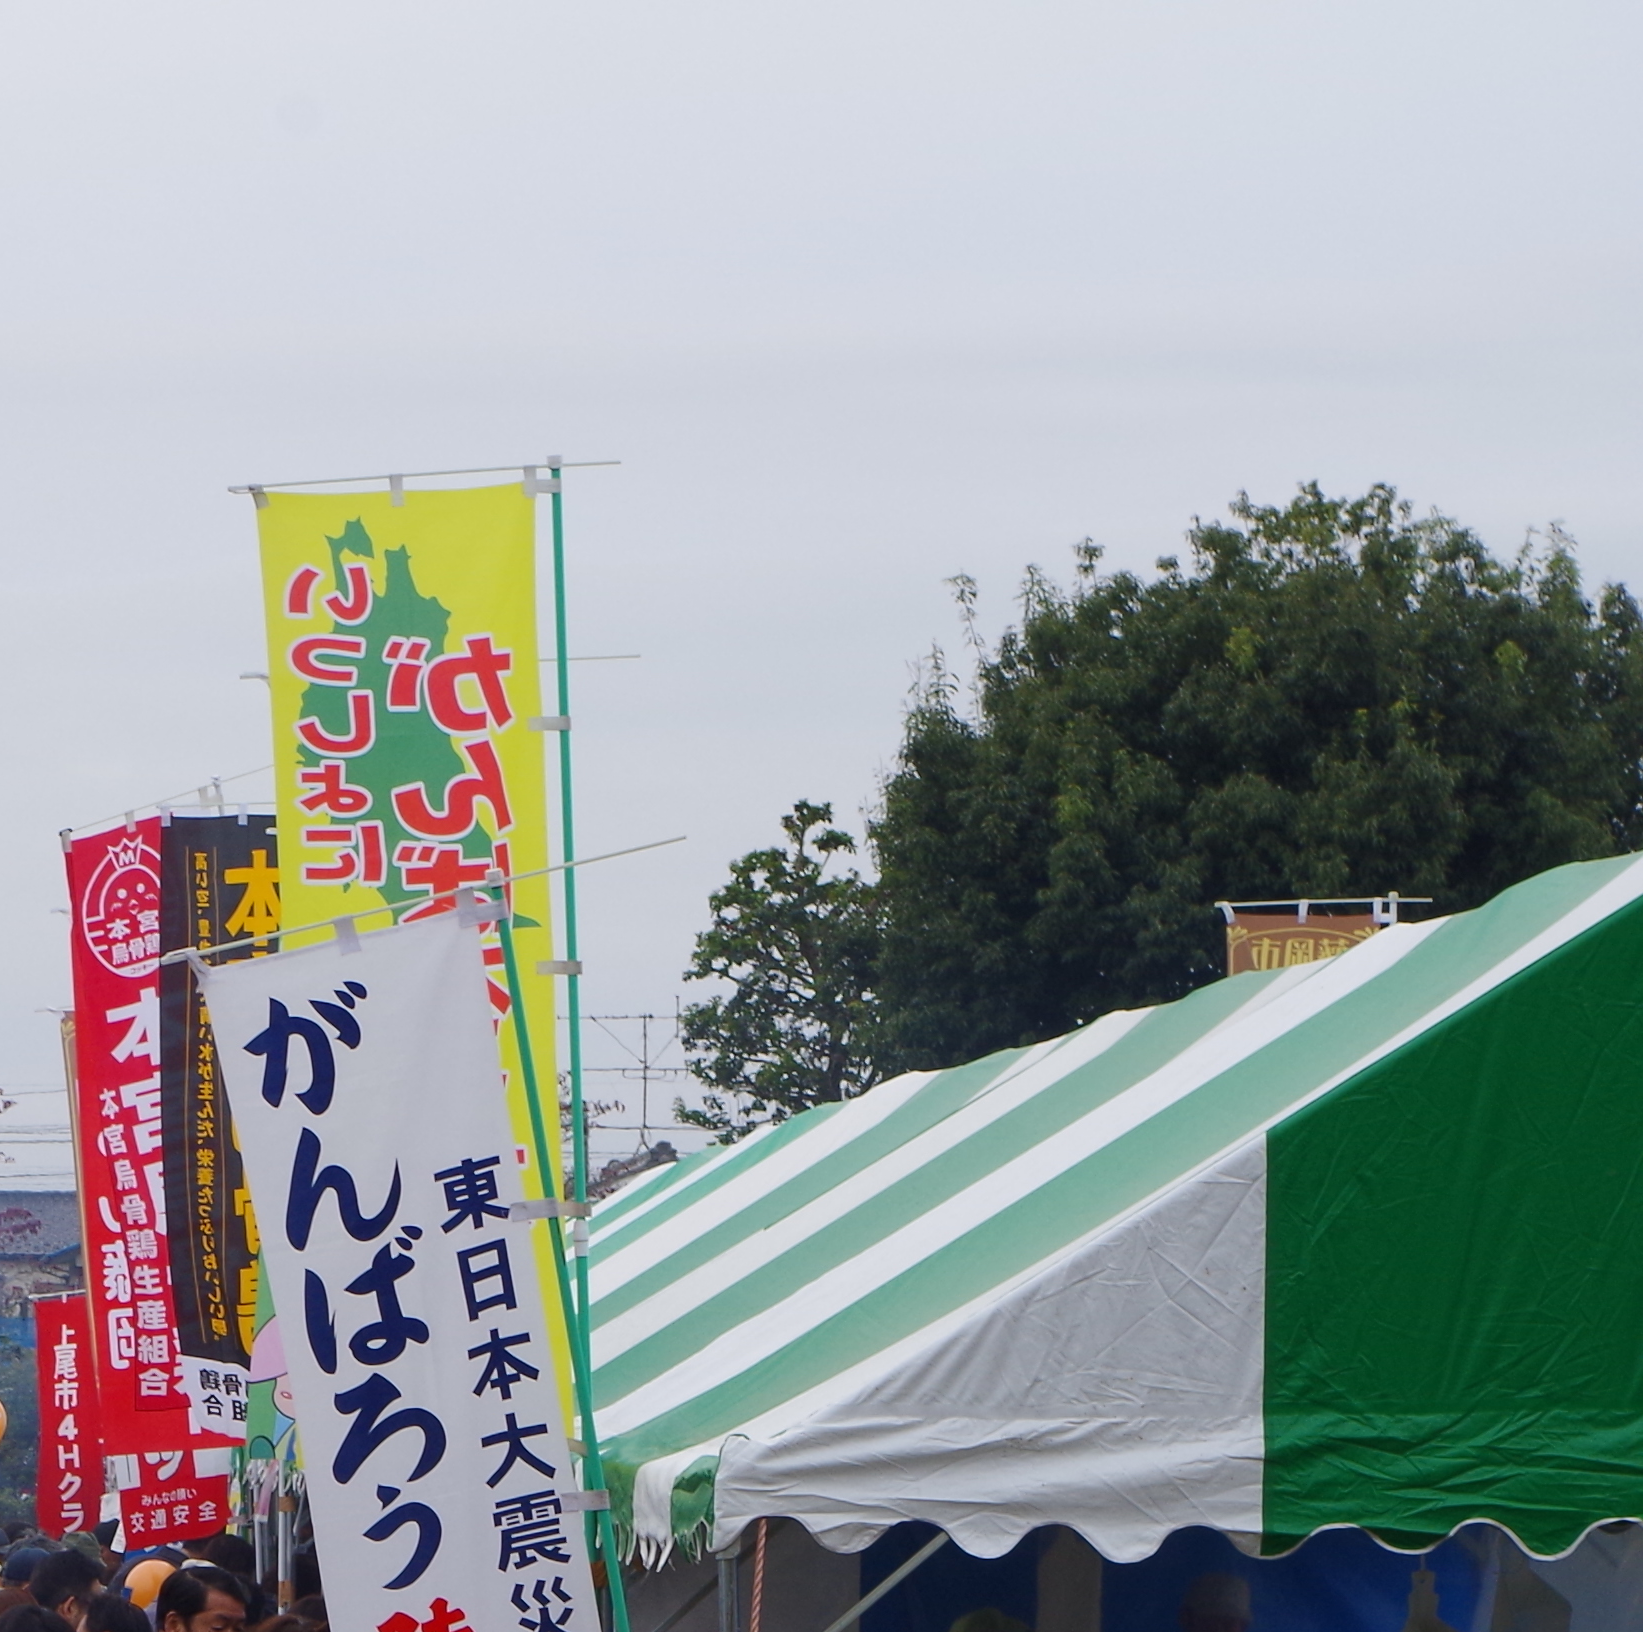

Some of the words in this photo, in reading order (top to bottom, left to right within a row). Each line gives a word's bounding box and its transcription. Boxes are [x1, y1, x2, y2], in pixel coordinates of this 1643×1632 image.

[99, 1087, 171, 1397] 本宮烏骨鶏生産組合
[244, 979, 447, 1590] がんばろう
[129, 1500, 218, 1534] 交通安全
